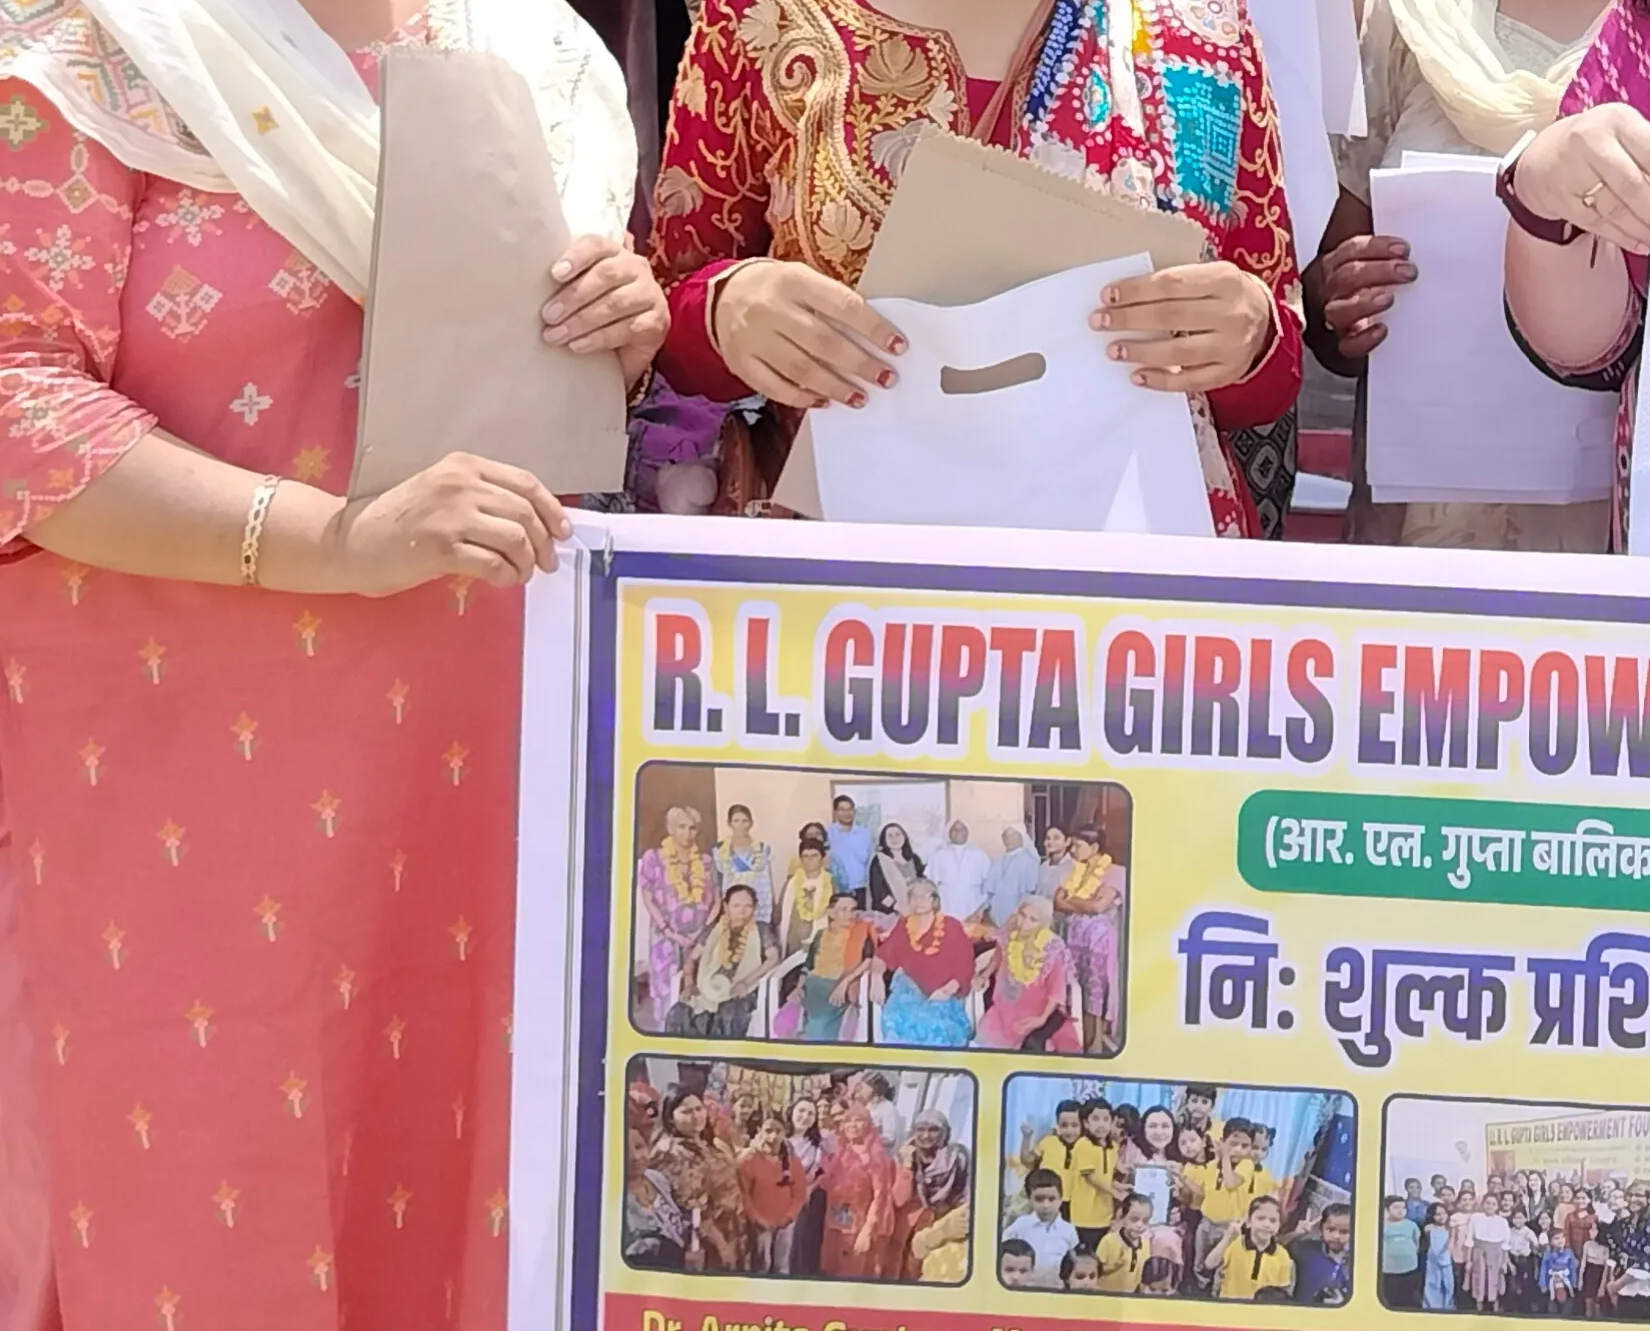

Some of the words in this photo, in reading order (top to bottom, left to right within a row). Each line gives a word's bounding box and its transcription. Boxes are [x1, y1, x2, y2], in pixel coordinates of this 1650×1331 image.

[653, 613, 723, 733] R.
[745, 617, 800, 737] L.
[823, 619, 1081, 751] GUPTA
[1104, 629, 1335, 764] GIRLS
[1362, 822, 1433, 869] एल.
[1441, 825, 1526, 890] गुप्ता
[1324, 946, 1516, 1069] शुल्क
